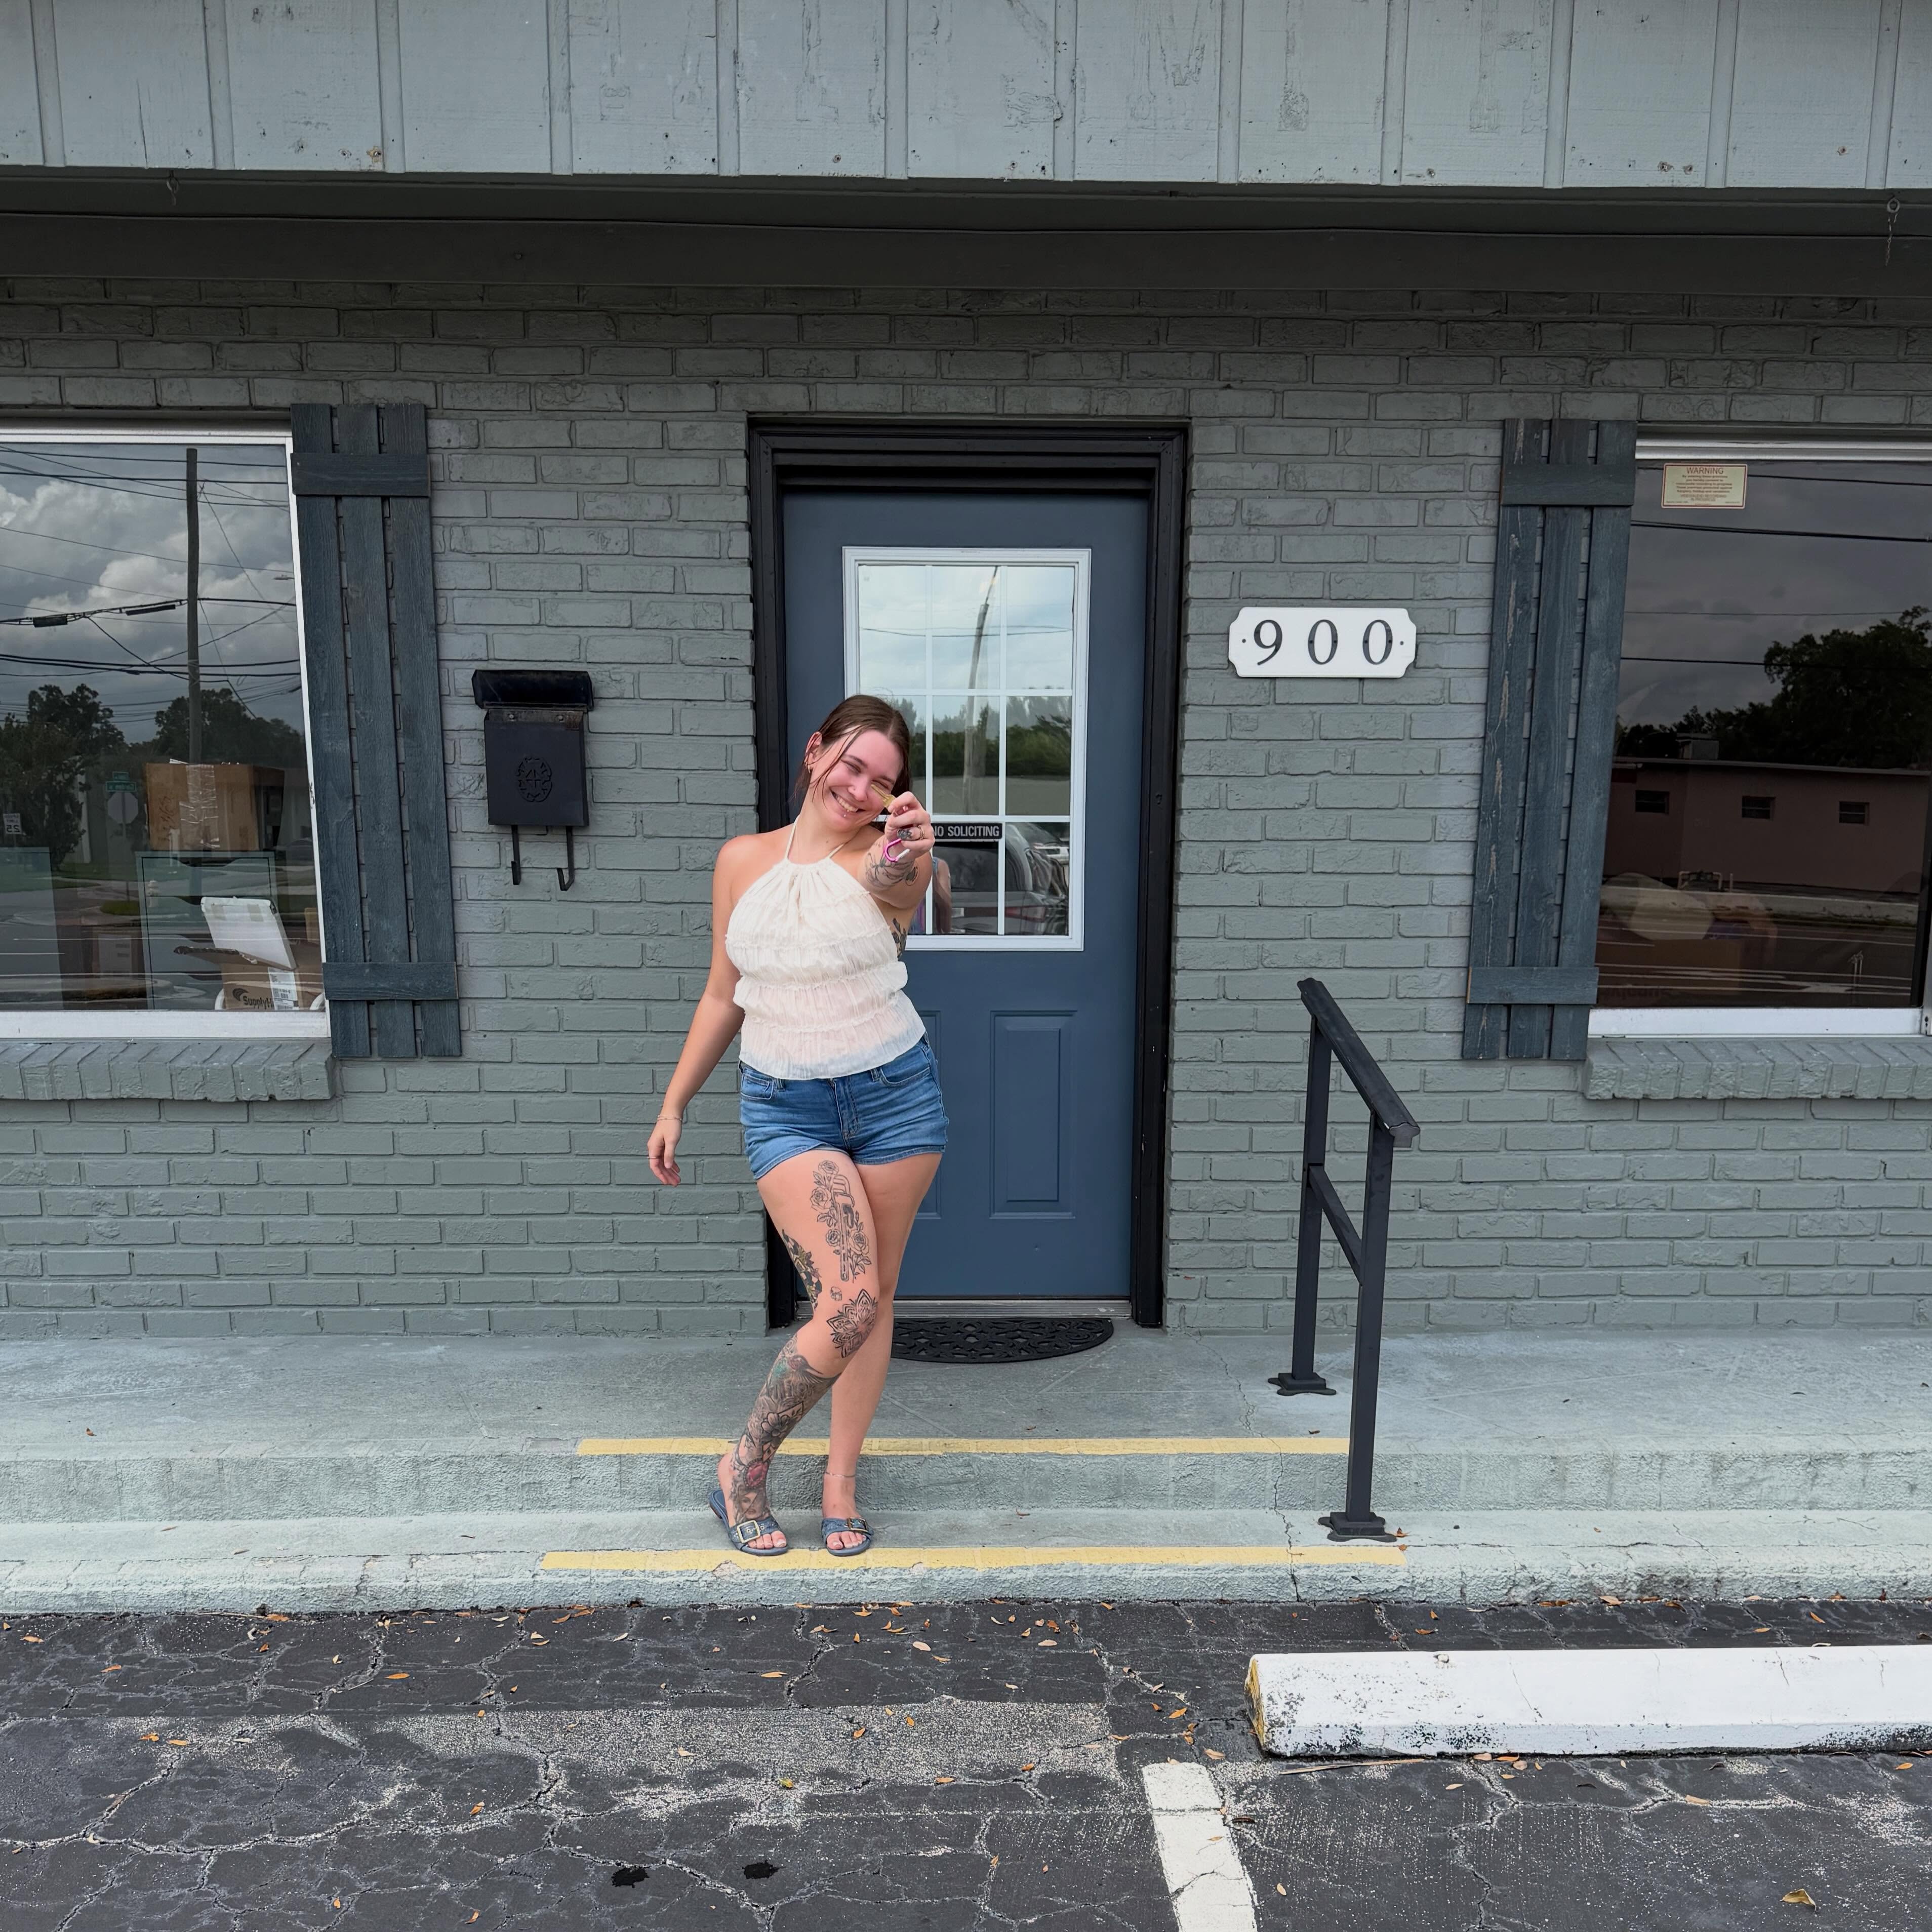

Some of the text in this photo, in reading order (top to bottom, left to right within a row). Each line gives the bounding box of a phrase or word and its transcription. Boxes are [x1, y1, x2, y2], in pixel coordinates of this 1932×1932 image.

[1254, 619, 1393, 665] 900
[947, 826, 999, 837] SOLICITING
[243, 995, 274, 1010] SupplyH
